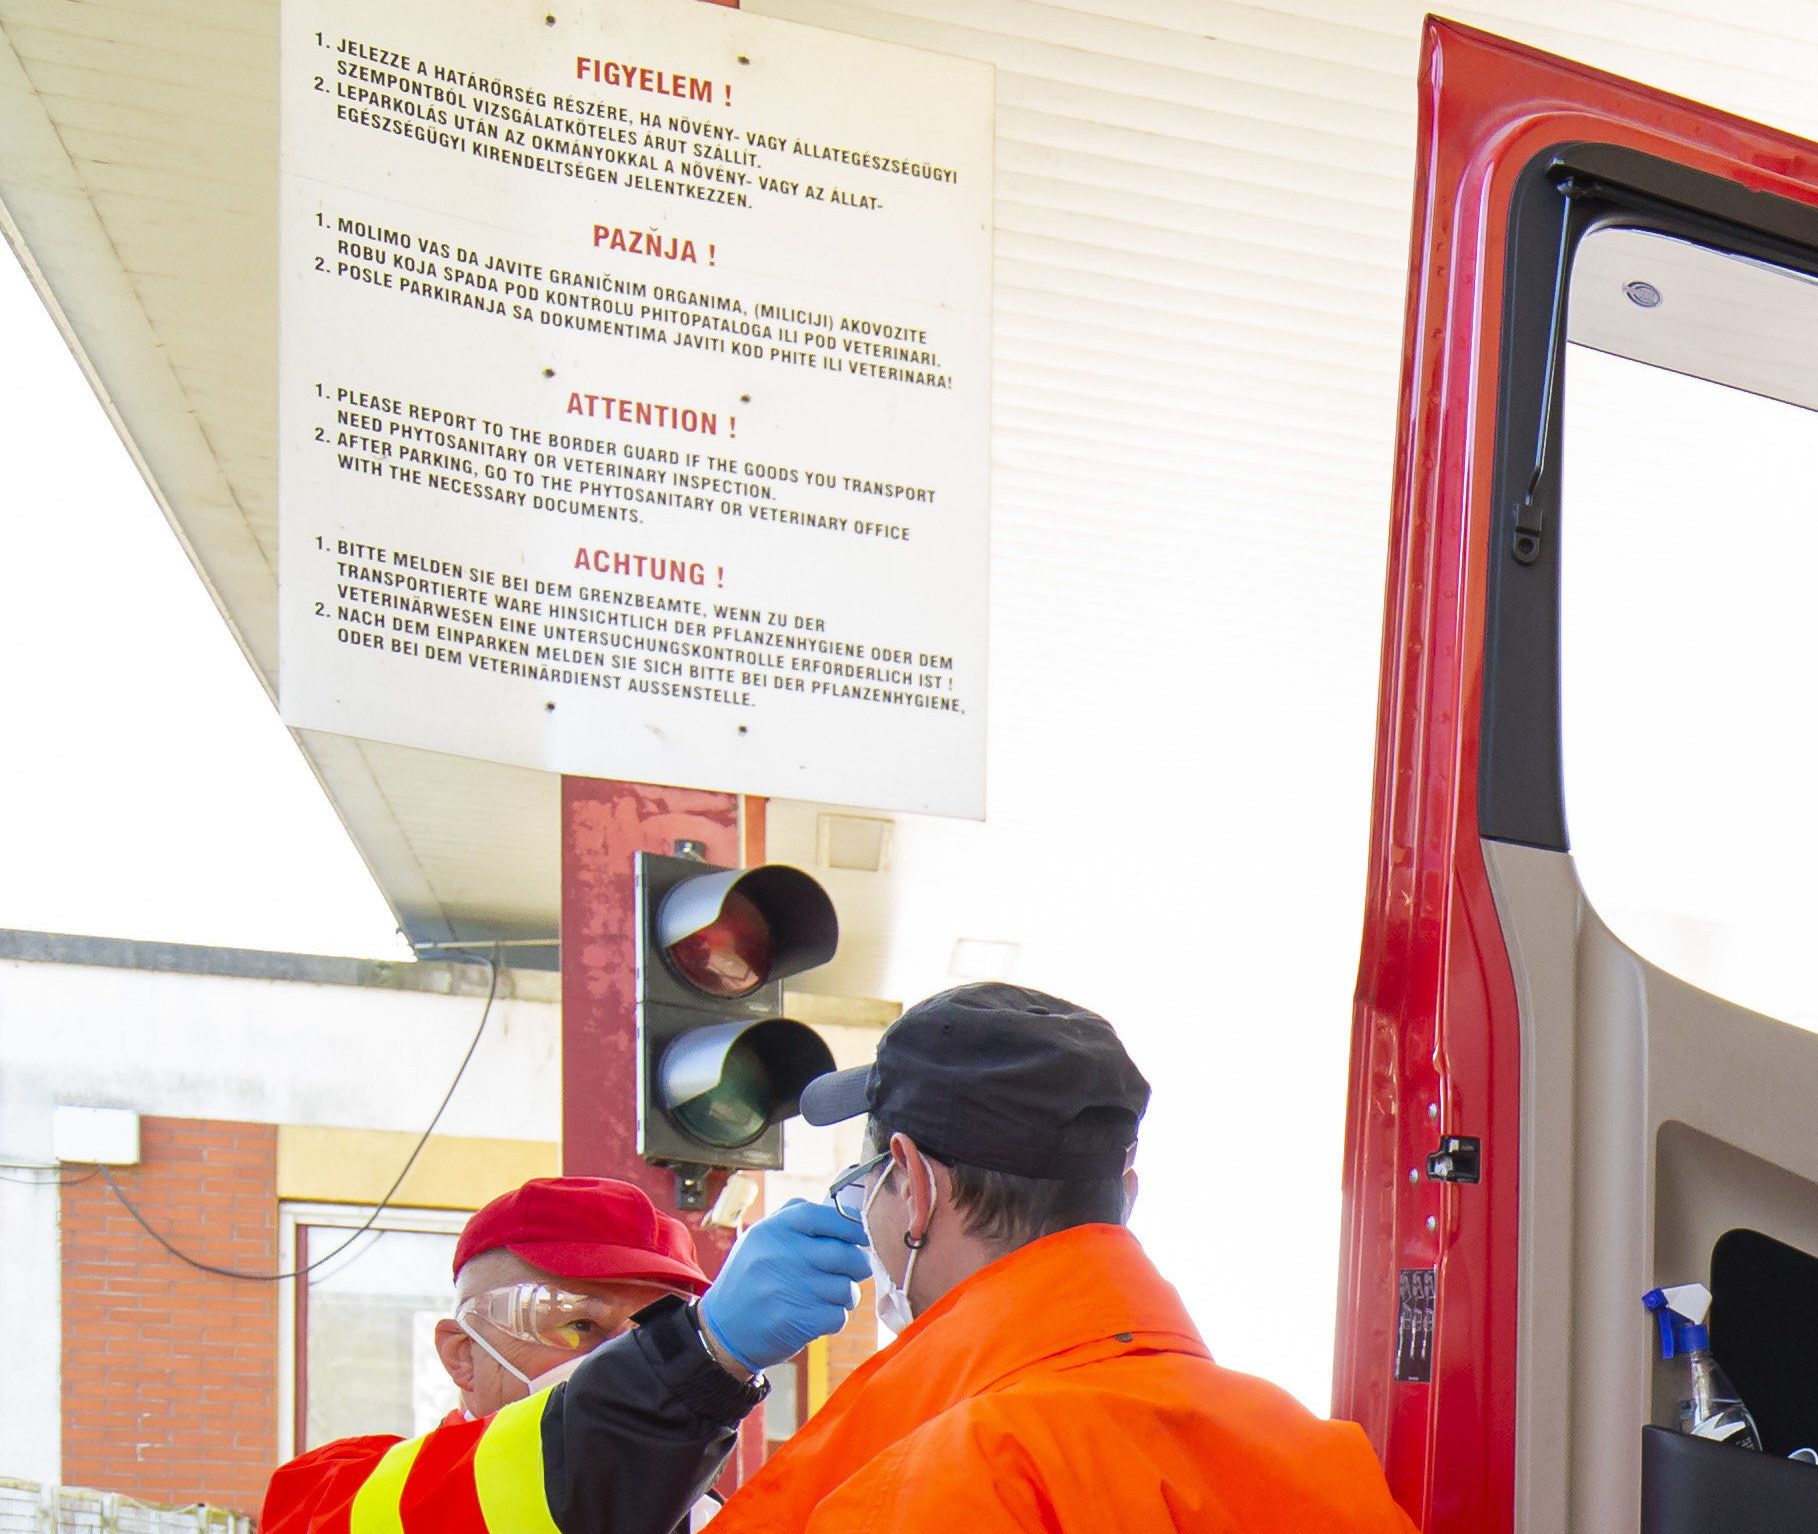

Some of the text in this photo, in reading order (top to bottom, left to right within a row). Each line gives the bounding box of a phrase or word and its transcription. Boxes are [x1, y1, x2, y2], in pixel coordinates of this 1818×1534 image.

[315, 32, 330, 48] 1.
[337, 38, 410, 71] JELEZZE
[417, 61, 427, 76] A
[640, 112, 661, 128] HA
[746, 132, 786, 151] VAGY
[793, 141, 957, 184] ÁLLATEGÉSZSÉGÜGYI
[337, 60, 466, 109] SZEMPONTBÓL
[473, 98, 637, 145] VIZSGÁLATKÖTELES
[644, 129, 687, 154] ÁRUT
[576, 56, 731, 107] FIGYELEM !
[314, 76, 330, 93] 2.
[337, 82, 447, 125] LEPARKOLÁS
[454, 114, 497, 139] UTÁN
[505, 128, 525, 146] AZ
[532, 135, 658, 170] OKMÁNYOKKAL
[665, 160, 674, 173] A
[758, 176, 799, 195] VAGY
[805, 186, 824, 200] AZ
[337, 104, 752, 209] EGÉSZSÉGÜGYI KIRENDELTSÉGEN JELENTKEZZEN.
[315, 213, 926, 344] 1. MOLIMO VAS DA JAVITE GRANIČNIM ORGANIMA, (MILICIJI) AKOVOZITE
[338, 240, 941, 368] ROBU KOJA SPADA POD KONTROLU PHITOPATALOGA ILI POD VETERINARI.
[709, 244, 715, 266] !
[315, 256, 952, 388] 2. POSLE PARKIRANJA SA DOKUMENTIMA JAVITI KOD PHITE ILI VETERINARA!
[316, 383, 935, 503] 1. PLEASE REPORT TO THE BORDER GUARD IF THE GOODS YOU TRANSPORT
[338, 410, 776, 500] NEED PHYTOSANITARY OR VETERINARY INSPECTION.
[567, 392, 735, 438] ATTENTION !
[315, 427, 909, 541] 2. AFTER PARKING, GO TO THE PHYTOSANITARY OR VETERINARY OFFICE
[338, 454, 643, 524] WITH THE NECESSARY DOCUMENTS.
[316, 536, 824, 632] 1. BITTE MELDEN SIE BEI DEM GRENZBEAMTE, WENN ZU DER
[337, 562, 952, 669] TRANSPORTIERTE WARE HINSICHTLICH DER PFLANZENHYGIENE ODER DEM
[575, 547, 723, 588] ACHTUNG !
[315, 602, 964, 714] 2. NACH DEM EINPARKEN MELDEN SIE SICH BITTE BEI DER PFLANZENHYGIENE,
[337, 584, 953, 691] VETERINÄRWESEN EINE UNTERSUCHUNGSKONTROLLE ERFORDERLICH IST !
[338, 628, 755, 707] ODER BEI DEM VETERINÄRDIENST AUSSENSTELLE.
